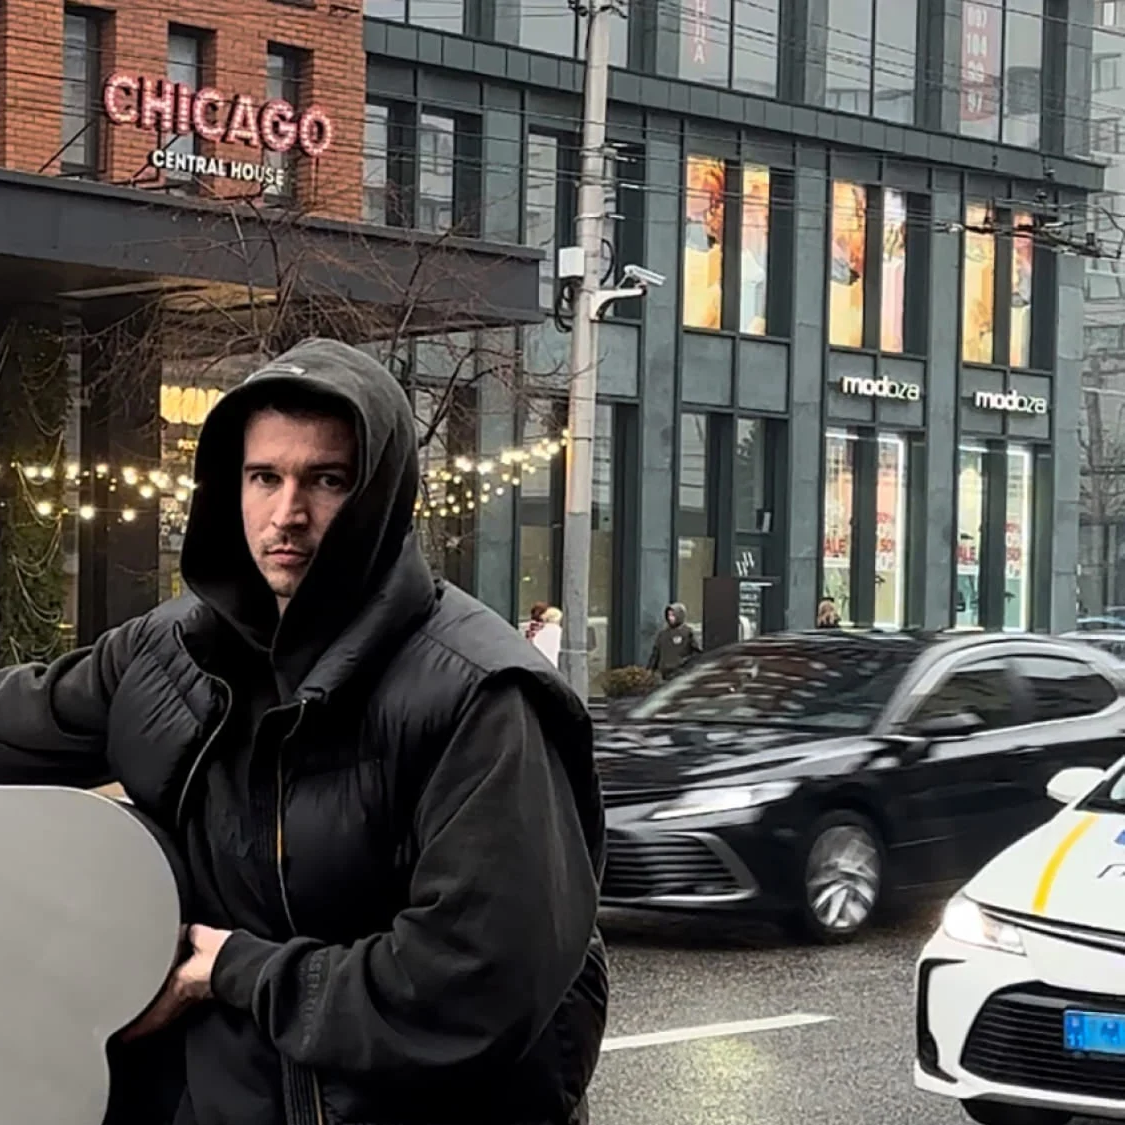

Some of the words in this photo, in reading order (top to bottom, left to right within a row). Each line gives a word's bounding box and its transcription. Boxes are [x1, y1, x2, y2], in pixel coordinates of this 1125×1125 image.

[104, 71, 333, 156] CHICAGO
[151, 150, 227, 177] CENTRAL
[230, 162, 285, 186] HOUSE
[842, 375, 921, 401] modoza
[975, 388, 1048, 414] modoza
